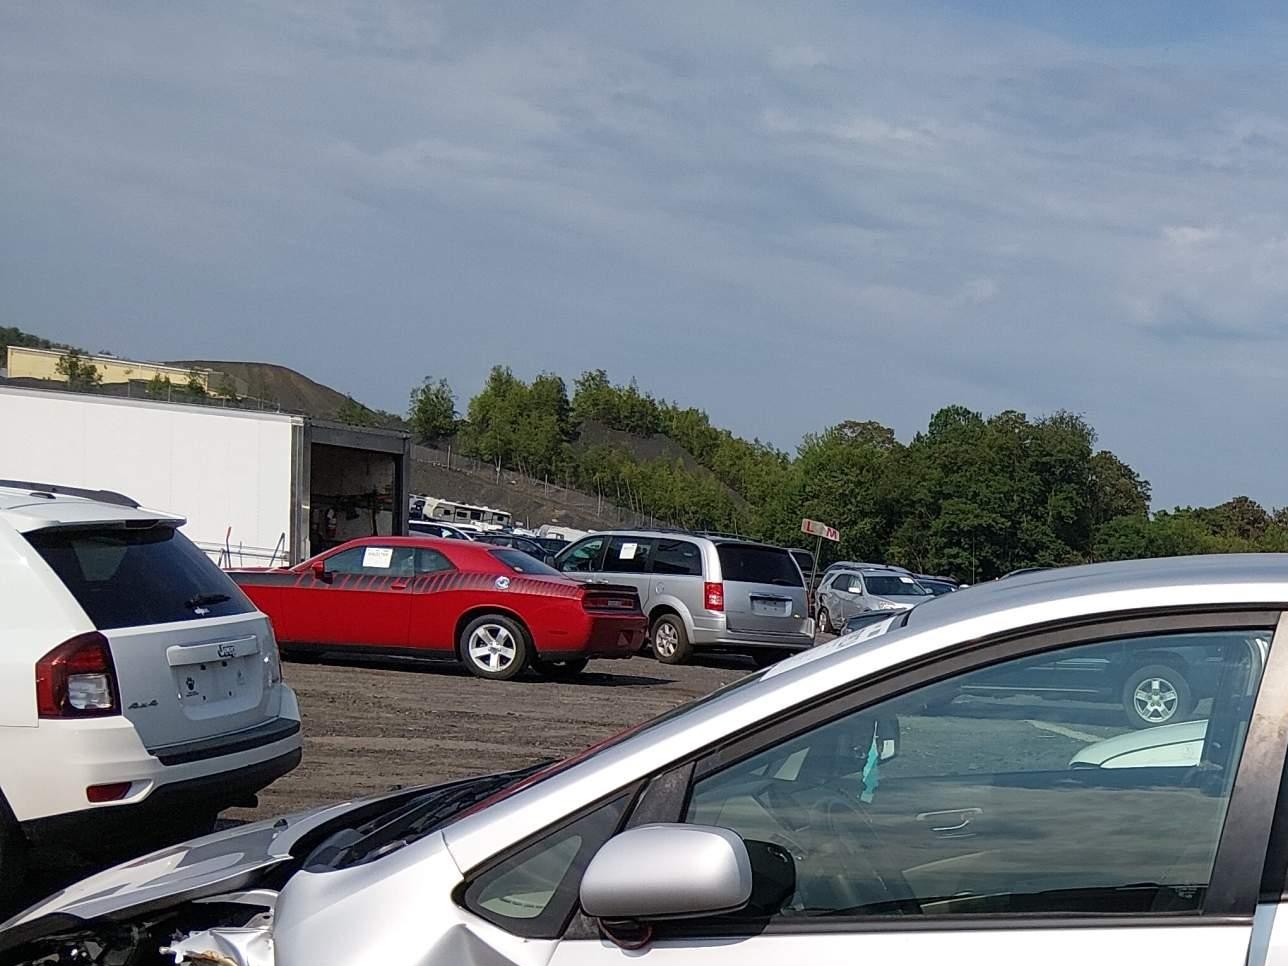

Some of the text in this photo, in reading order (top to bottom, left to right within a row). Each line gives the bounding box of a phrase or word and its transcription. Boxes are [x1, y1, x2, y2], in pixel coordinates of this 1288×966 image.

[806, 521, 837, 539] L M
[217, 644, 236, 658] Jeep
